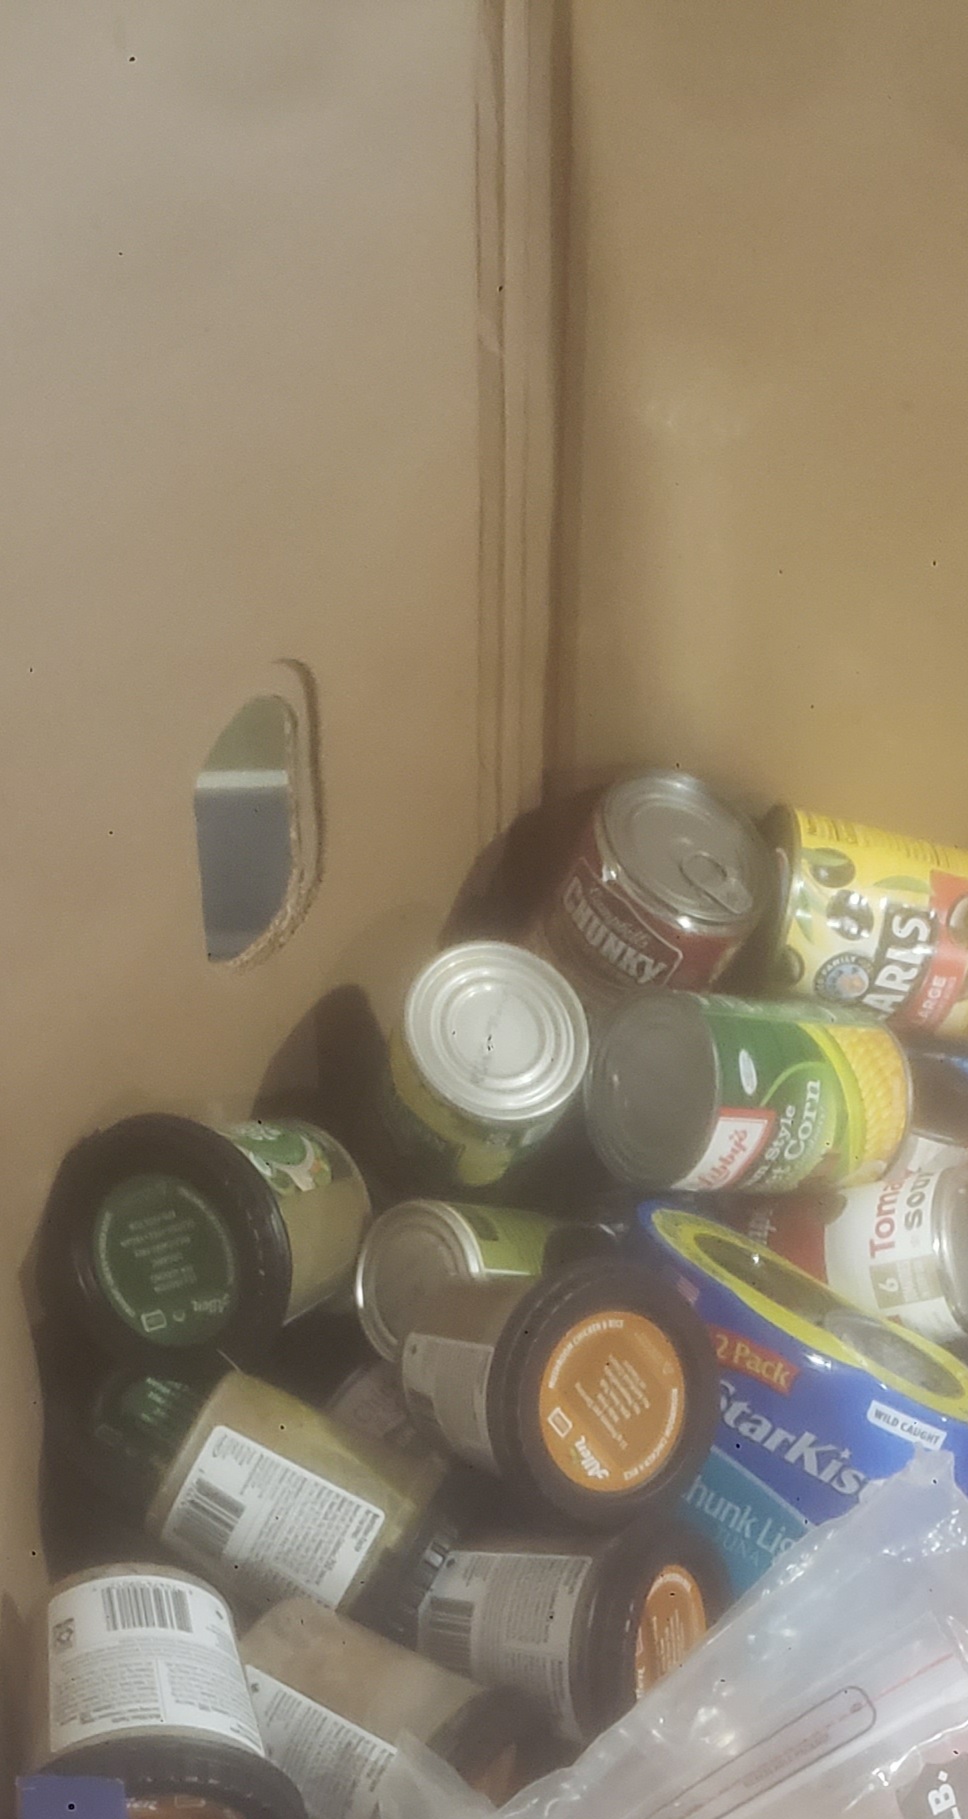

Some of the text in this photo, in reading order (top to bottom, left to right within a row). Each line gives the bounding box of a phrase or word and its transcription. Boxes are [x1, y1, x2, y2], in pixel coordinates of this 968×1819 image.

[563, 875, 668, 984] CHUNKY
[784, 1079, 821, 1161] Corn
[715, 1333, 791, 1387] 2 Pack
[719, 1379, 864, 1496] StarKis
[873, 1407, 942, 1448] WILD CAUGHT
[690, 1474, 757, 1538] hunk
